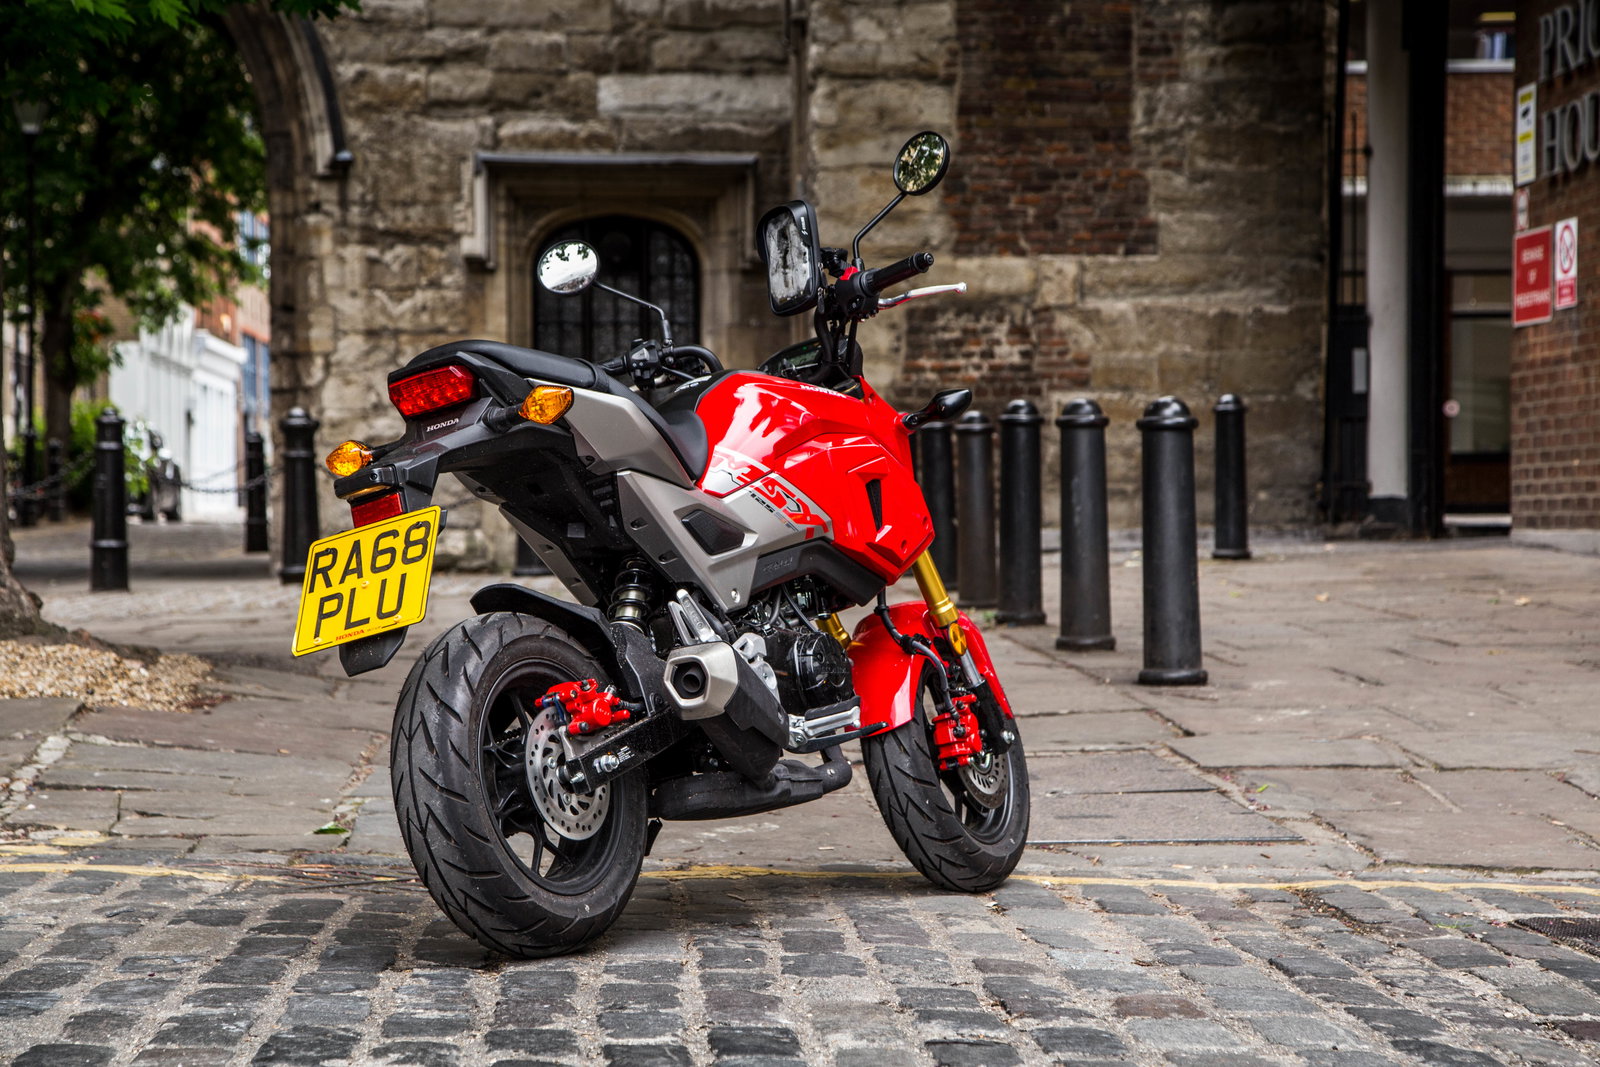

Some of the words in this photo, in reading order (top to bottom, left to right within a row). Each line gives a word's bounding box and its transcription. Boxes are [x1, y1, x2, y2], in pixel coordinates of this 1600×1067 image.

[426, 417, 460, 433] HONDA
[308, 520, 431, 594] RA68
[313, 572, 407, 640] PLU
[336, 629, 364, 641] HONDA
